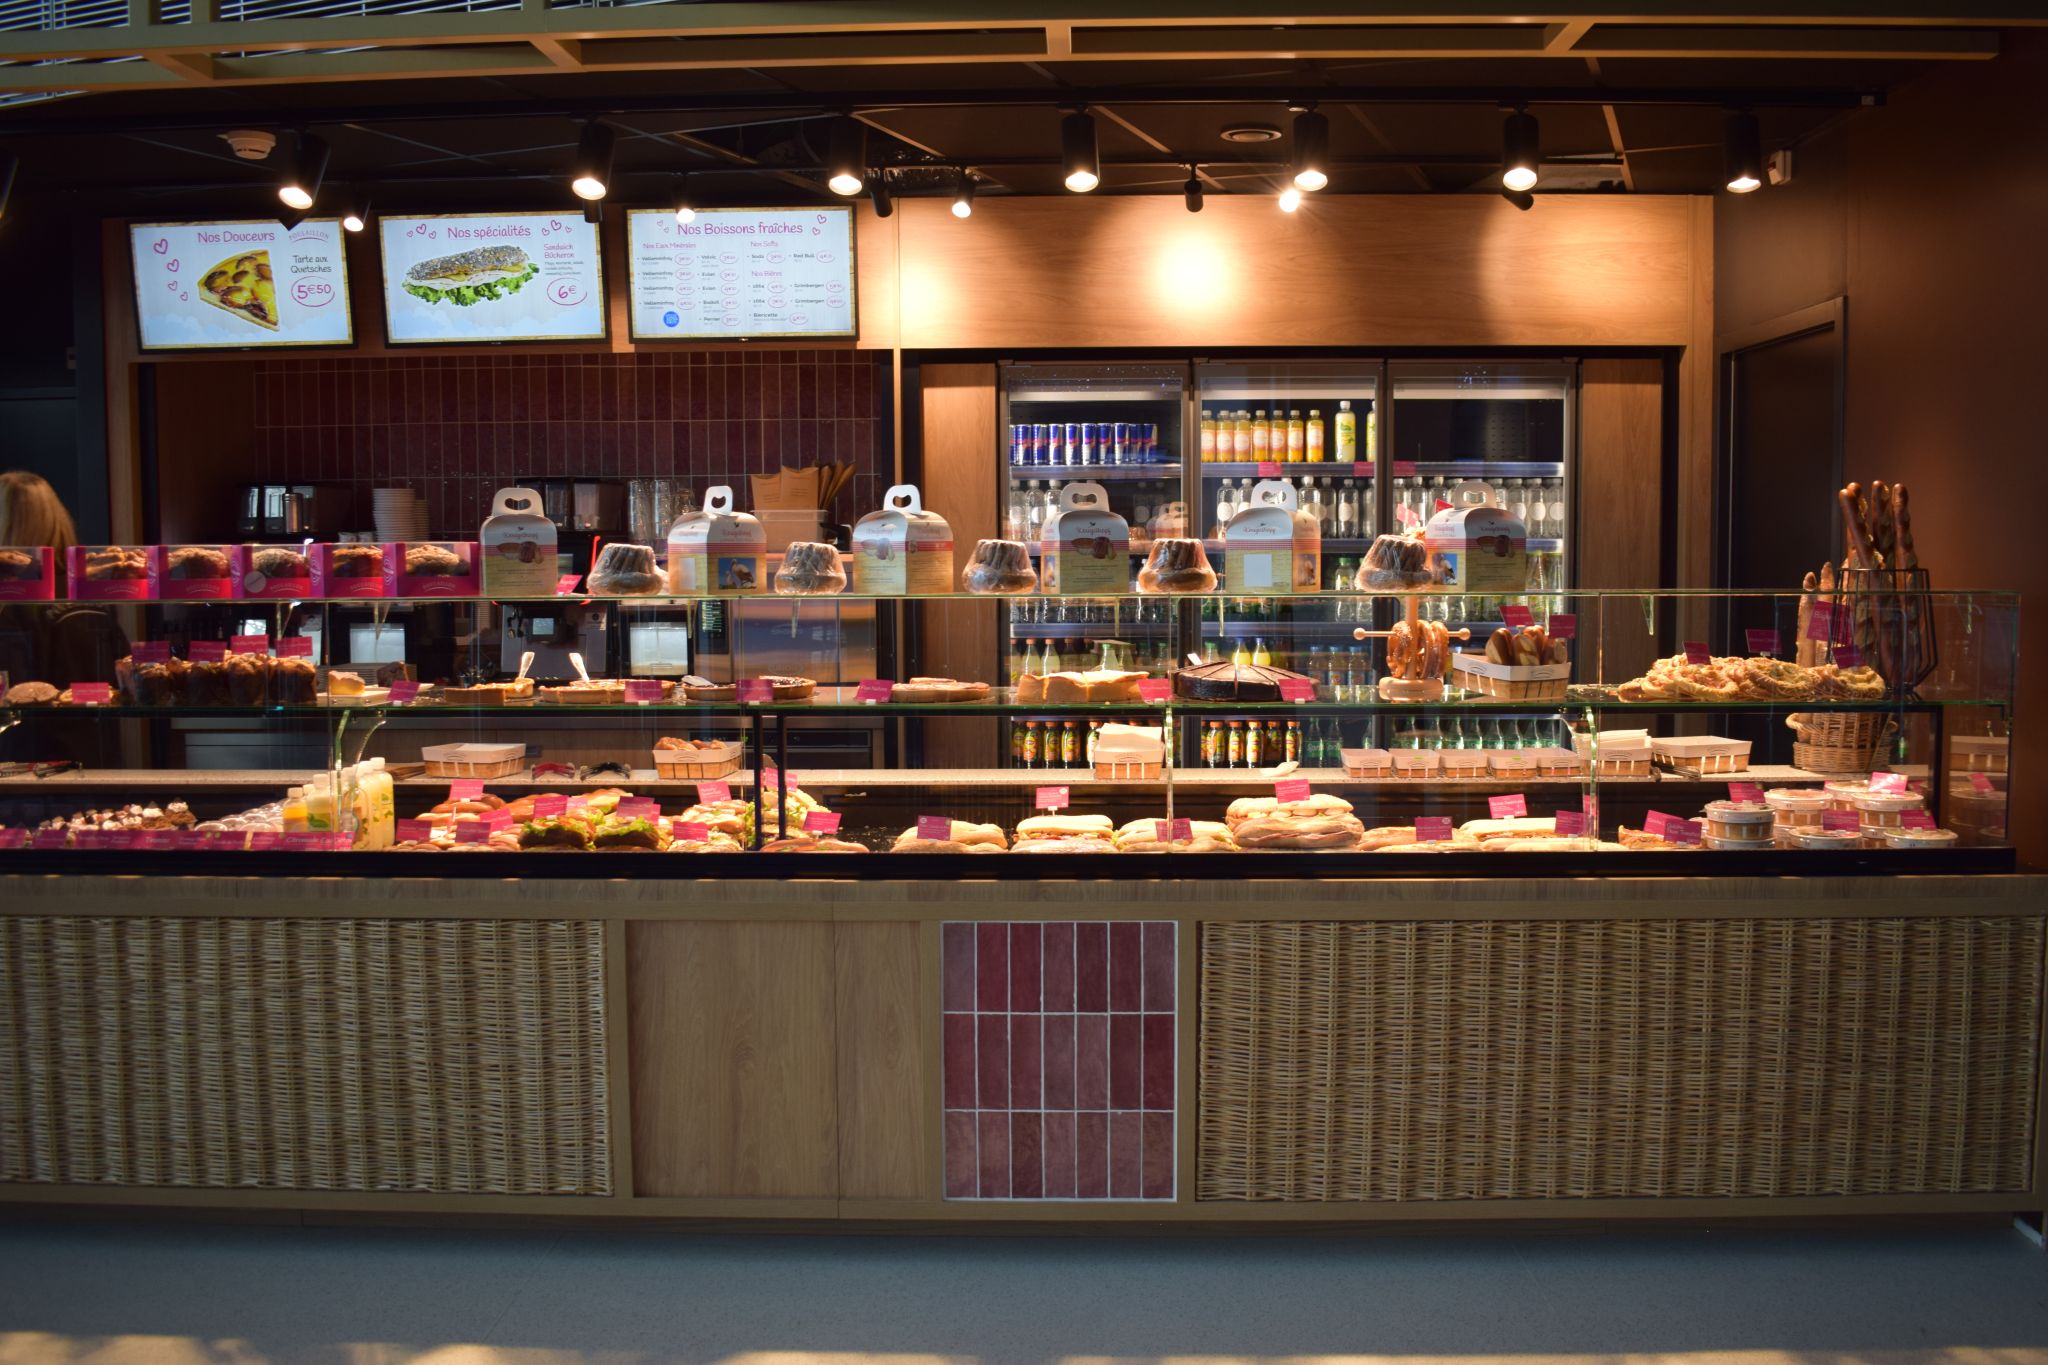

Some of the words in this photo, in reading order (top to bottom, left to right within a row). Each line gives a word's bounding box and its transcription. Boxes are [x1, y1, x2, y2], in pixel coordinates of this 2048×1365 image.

[447, 227, 471, 239] Nos
[473, 226, 531, 240] spécialités
[677, 223, 701, 235] Nos
[704, 223, 755, 235] Boissons
[758, 221, 803, 235] fraîches
[197, 232, 220, 243] Nos
[223, 230, 275, 243] Douceurs
[292, 254, 313, 263] Tarte
[291, 265, 332, 273] Quetsches
[297, 284, 331, 299] 5€50
[558, 285, 576, 298] 6€
